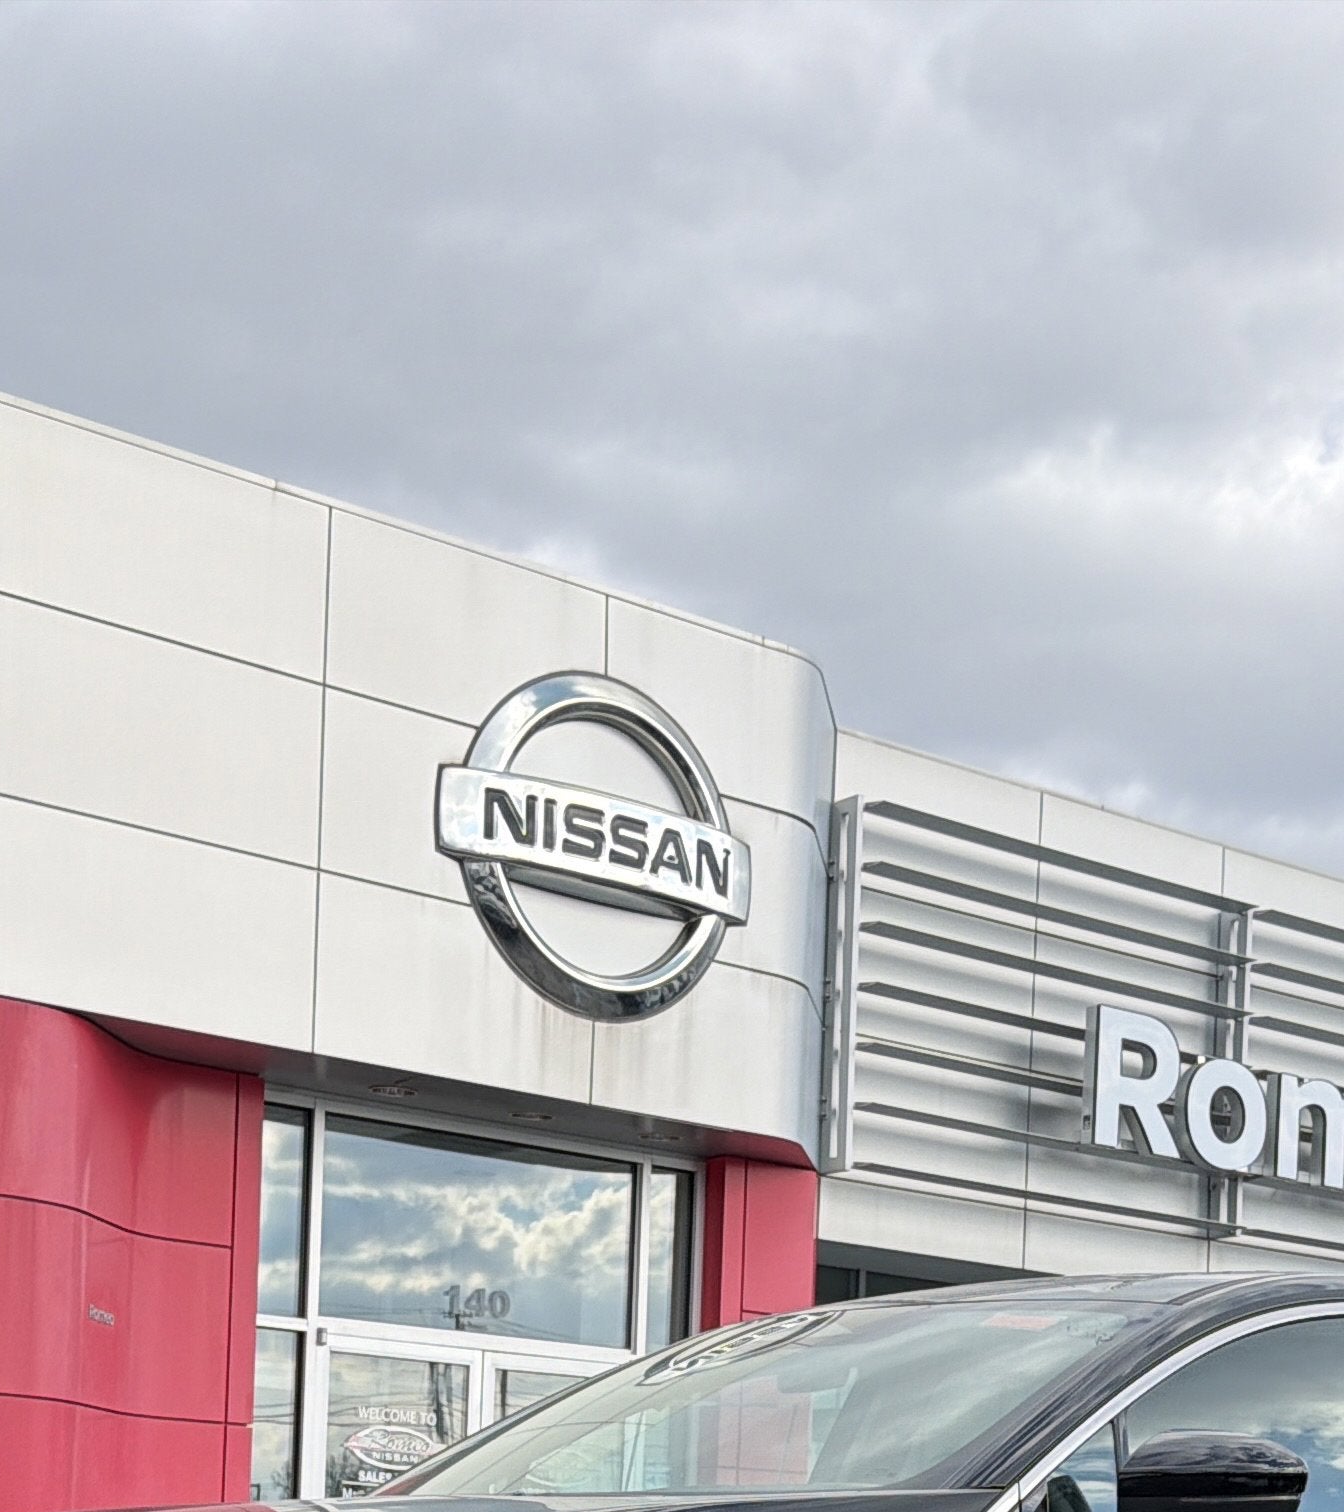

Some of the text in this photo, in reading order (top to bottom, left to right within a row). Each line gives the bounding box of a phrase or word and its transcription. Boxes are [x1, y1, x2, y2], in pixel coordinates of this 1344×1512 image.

[482, 786, 732, 899] NISSAN
[443, 1284, 511, 1318] 140
[358, 1406, 437, 1426] WELCOME TO
[368, 1428, 432, 1454] Romeo
[372, 1451, 419, 1464] NISSAN
